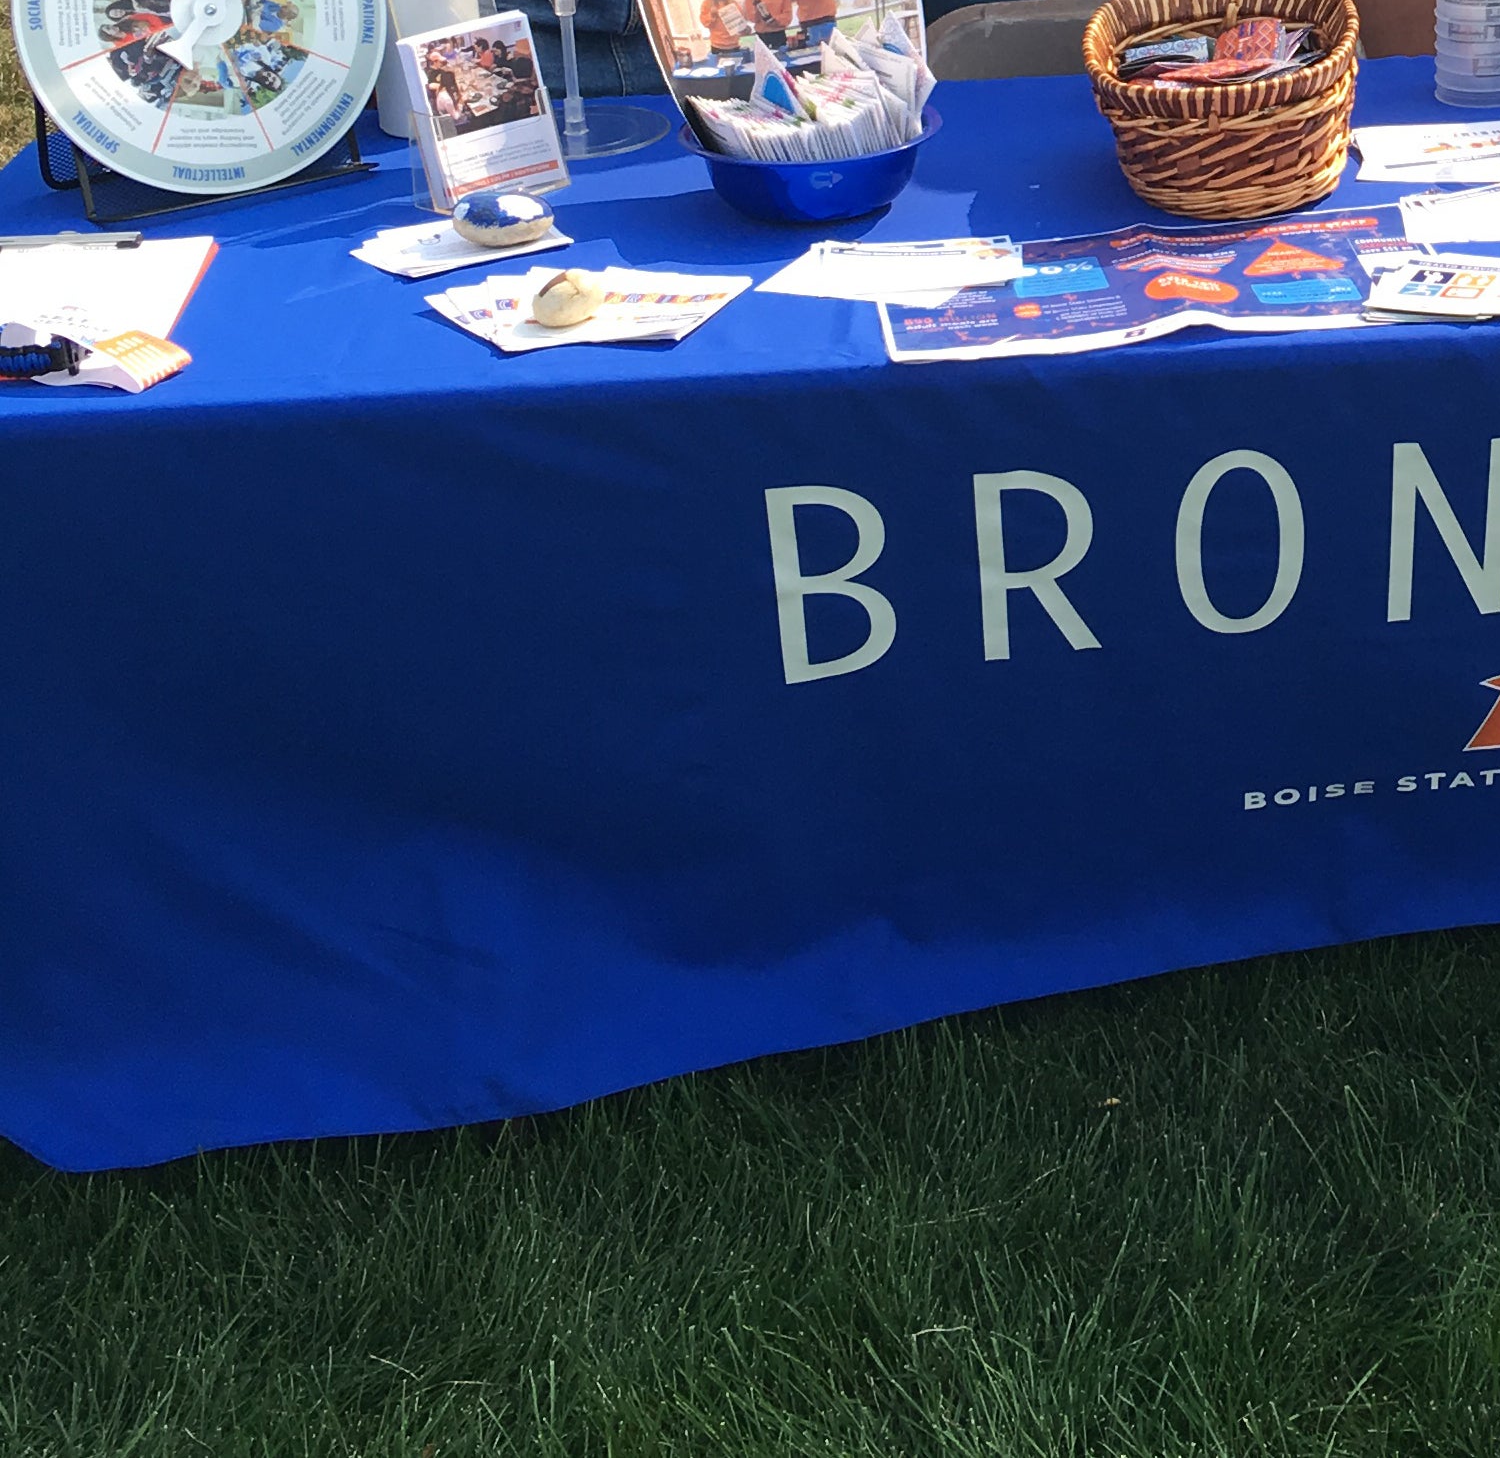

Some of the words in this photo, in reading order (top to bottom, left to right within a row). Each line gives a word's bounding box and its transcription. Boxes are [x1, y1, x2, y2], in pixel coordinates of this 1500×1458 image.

[72, 109, 122, 155] SPIRITUAL
[290, 92, 355, 157] ENVIRONMENTAL
[172, 165, 247, 182] INTELLECTUAL
[1243, 780, 1375, 811] BOISE
